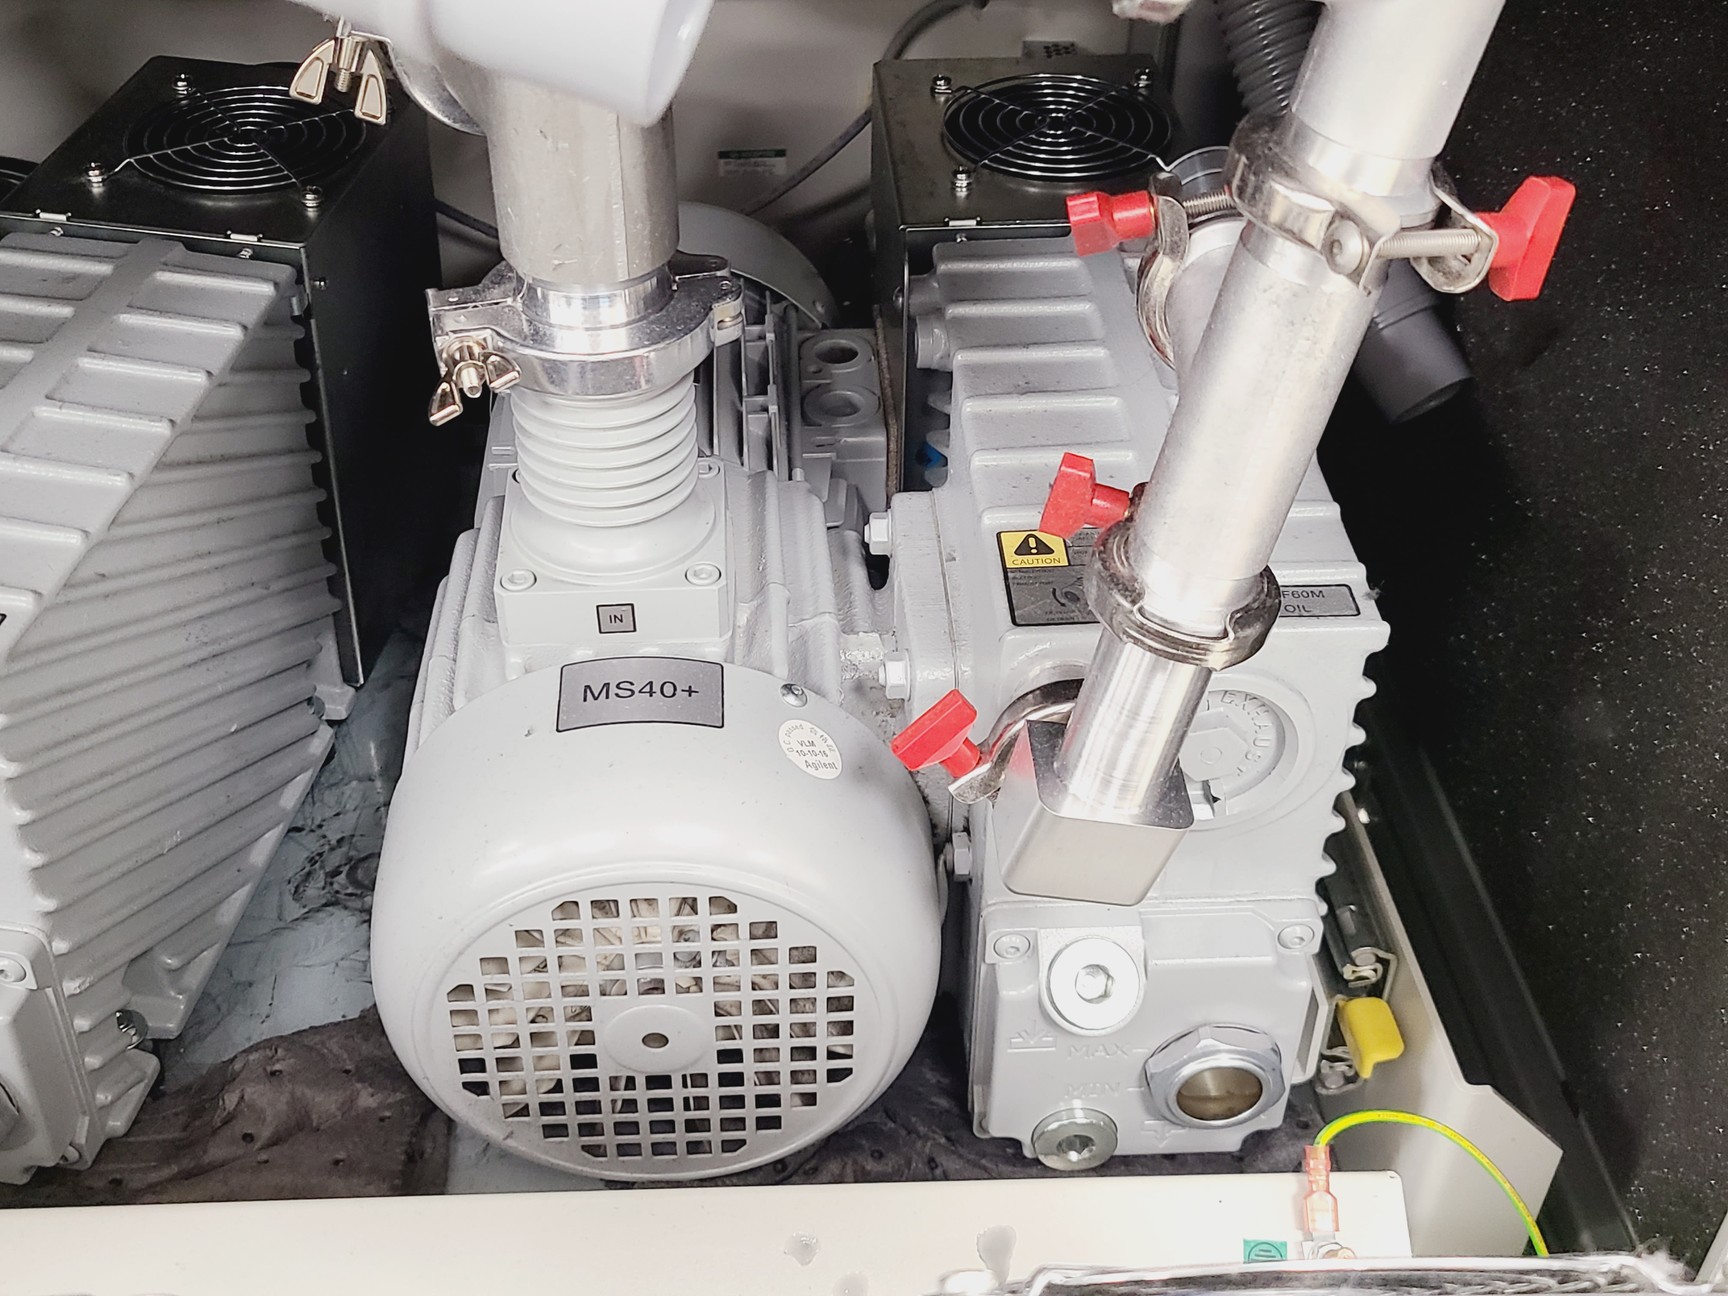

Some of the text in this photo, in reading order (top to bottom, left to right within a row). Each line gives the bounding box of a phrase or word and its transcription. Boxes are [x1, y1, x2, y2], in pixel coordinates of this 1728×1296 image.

[1012, 557, 1061, 566] CAUTION
[1280, 590, 1325, 599] F60M
[1284, 604, 1313, 613] OIL
[609, 614, 624, 624] IN
[582, 680, 700, 703] MS40+
[796, 739, 817, 747] VLM
[804, 759, 838, 771] Agilent
[1067, 1043, 1129, 1059] MAX
